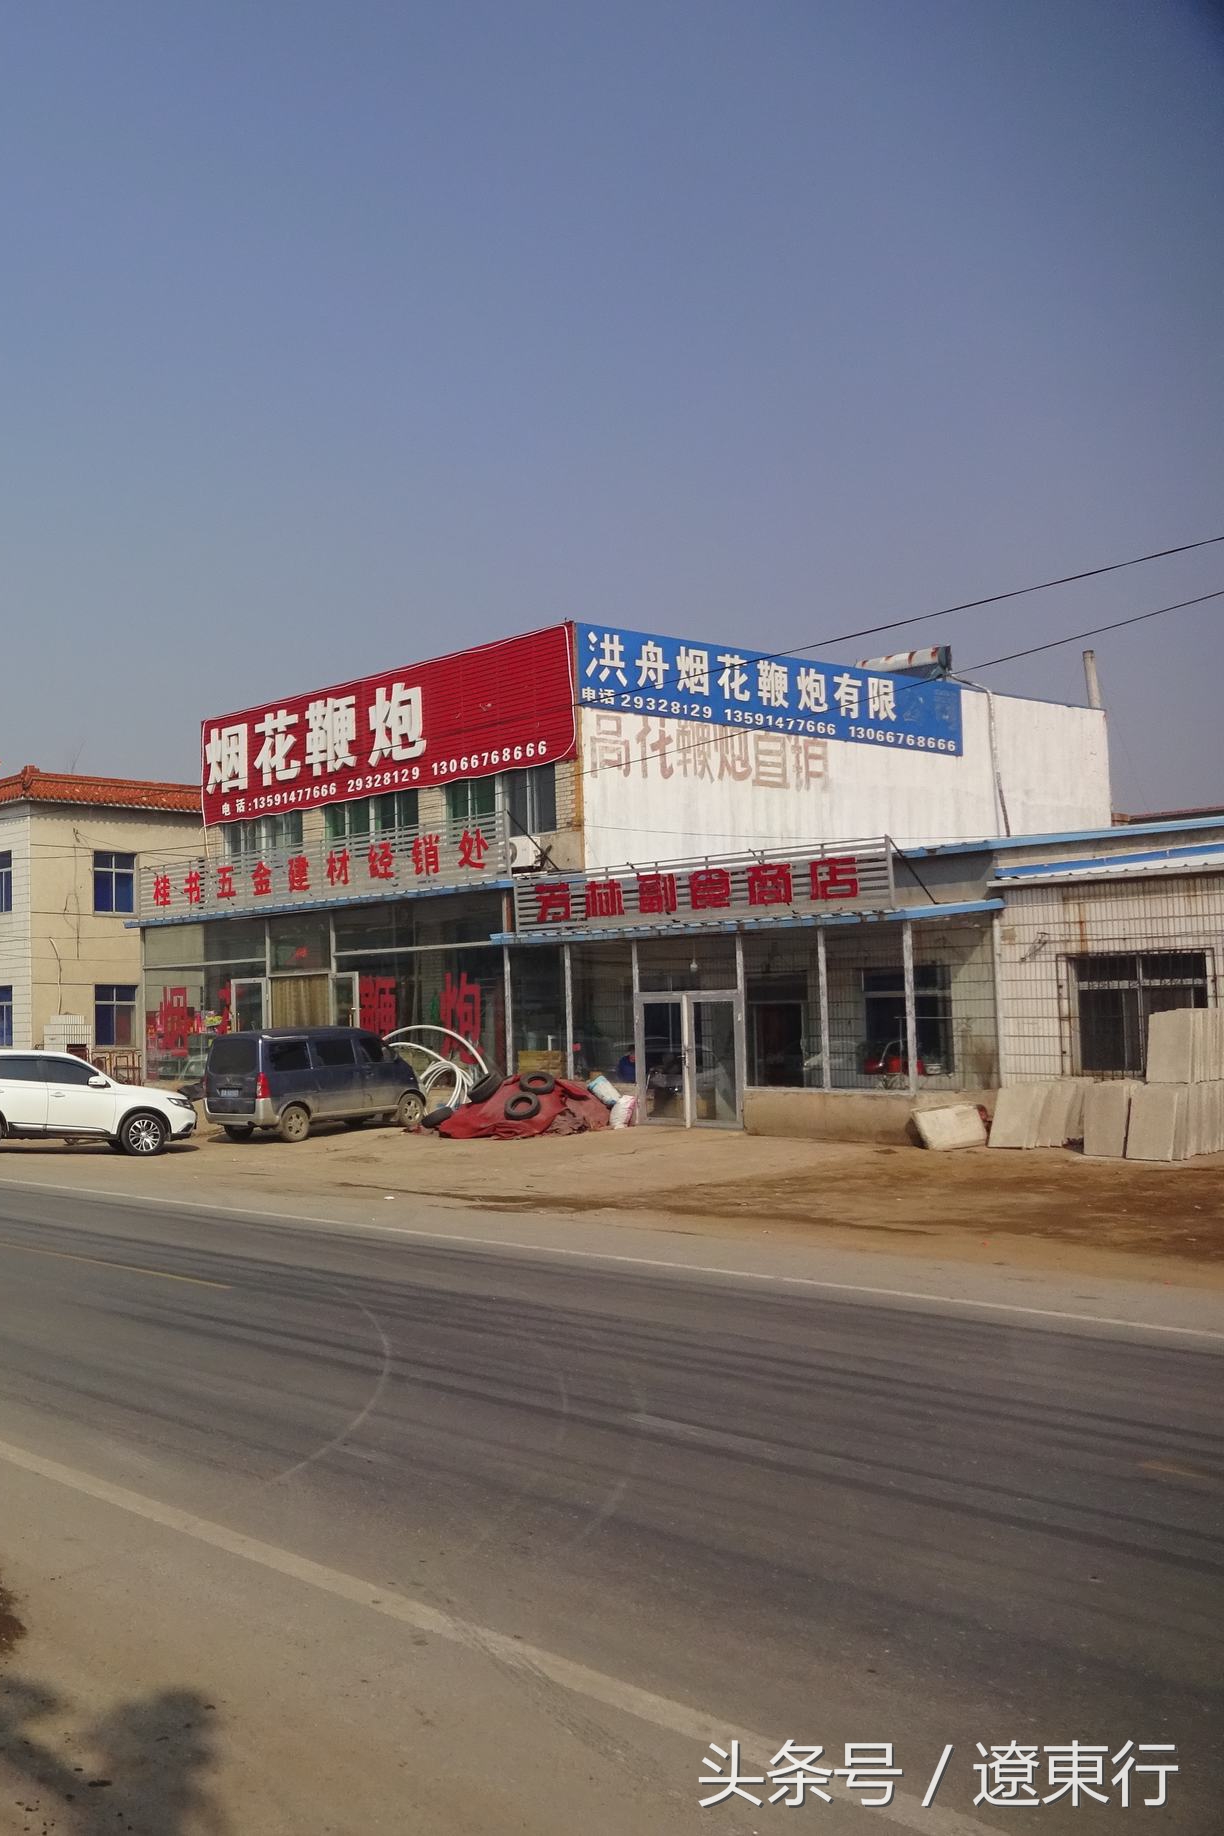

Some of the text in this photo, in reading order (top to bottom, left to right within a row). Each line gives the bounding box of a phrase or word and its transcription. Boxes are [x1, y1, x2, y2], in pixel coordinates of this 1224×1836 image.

[584, 631, 898, 722] 洪舟烟花鞭炮有限
[205, 682, 427, 795] 烟花鞭炮
[581, 687, 957, 752] 电话 29328129 13591477666 13066768666
[347, 766, 421, 793] 29328129
[431, 741, 548, 776] 13066768666
[535, 857, 860, 922] 芳林副食商店
